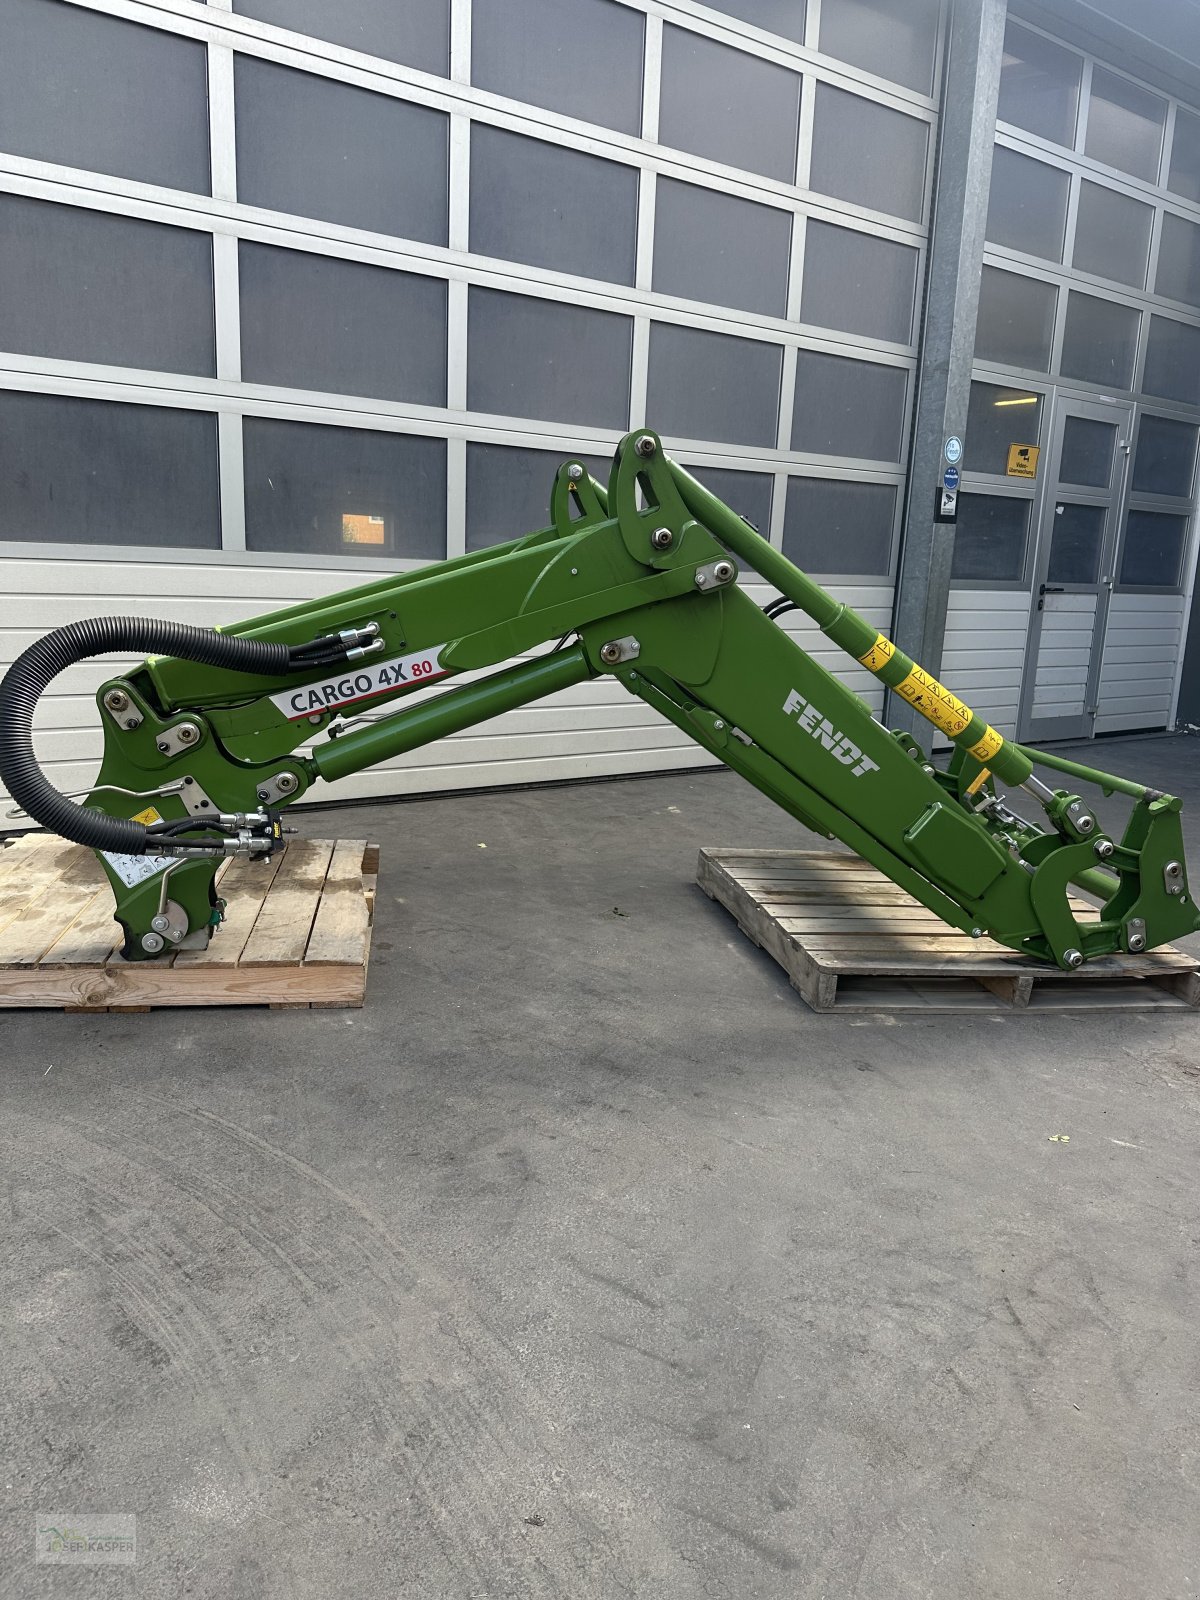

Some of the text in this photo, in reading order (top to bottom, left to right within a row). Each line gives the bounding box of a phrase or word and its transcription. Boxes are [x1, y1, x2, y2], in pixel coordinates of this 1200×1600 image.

[291, 660, 433, 712] CARGO 4X 80
[782, 688, 881, 777] FENDT
